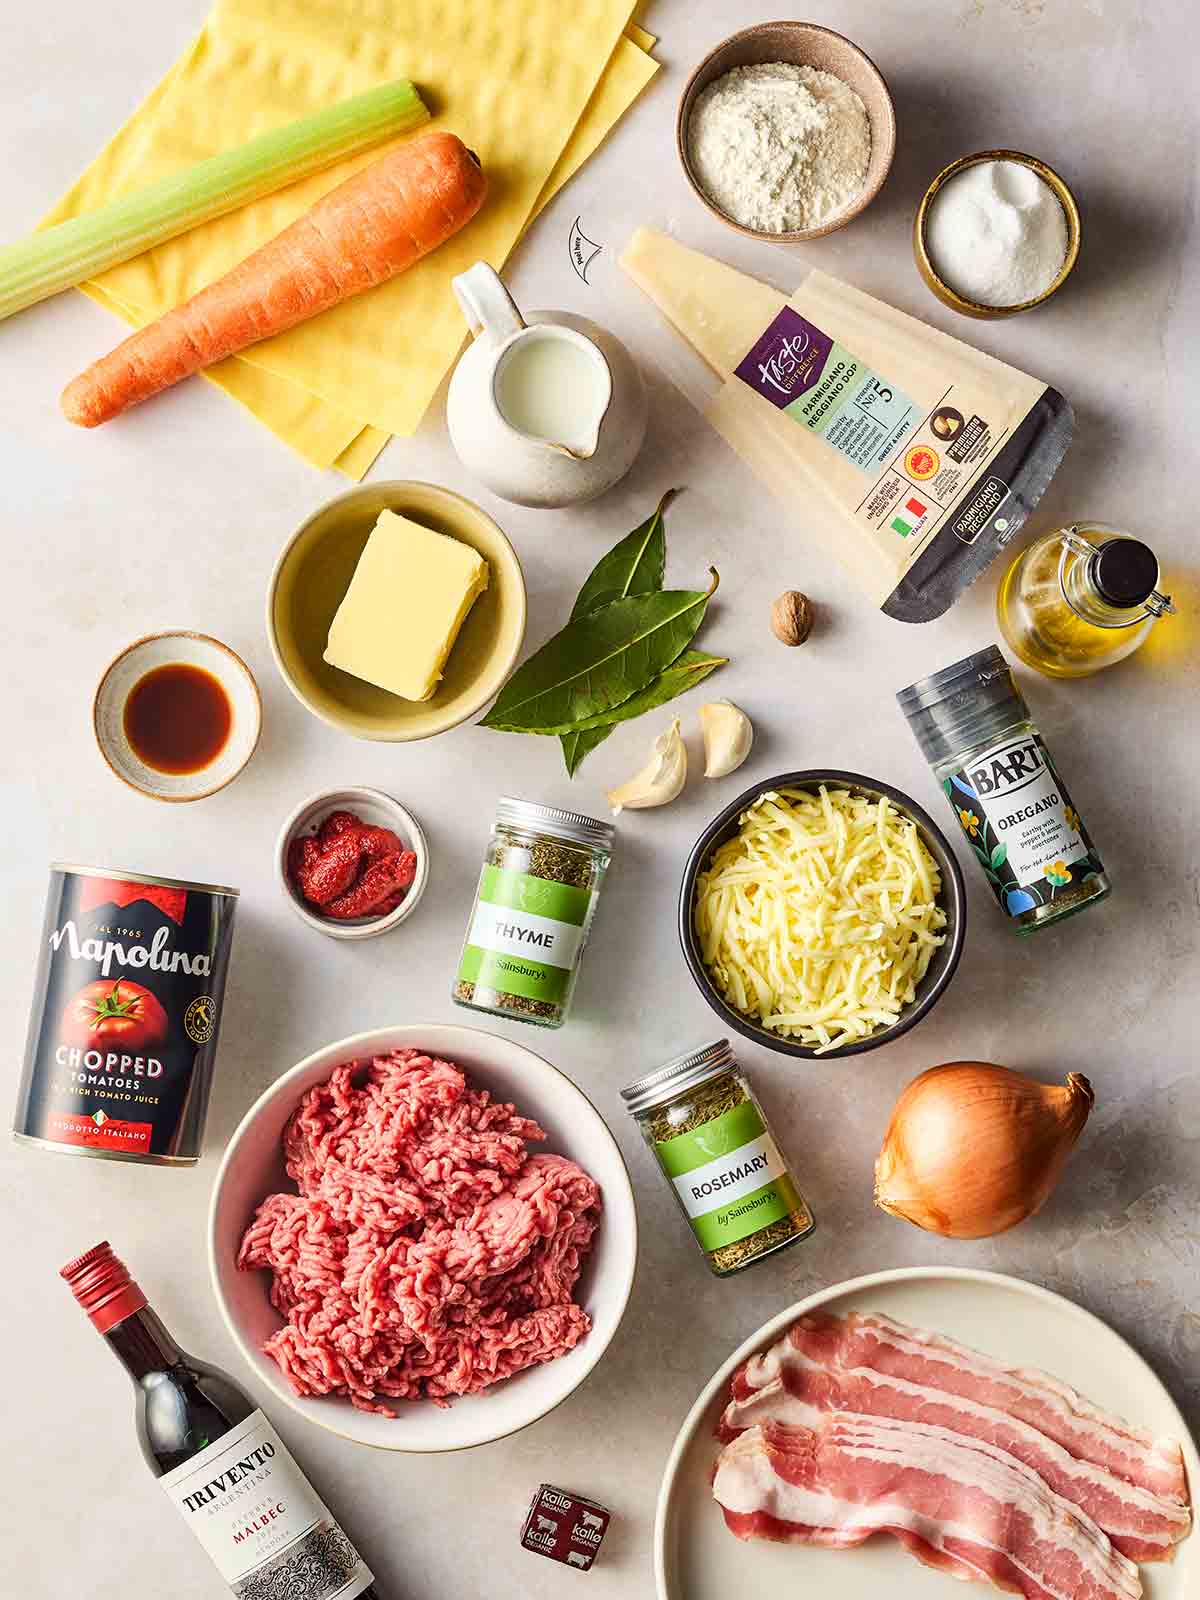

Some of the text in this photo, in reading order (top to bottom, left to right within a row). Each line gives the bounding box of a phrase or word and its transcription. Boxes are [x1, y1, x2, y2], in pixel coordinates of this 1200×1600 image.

[574, 251, 584, 265] Peel
[758, 330, 809, 394] taste
[784, 348, 819, 390] DIFFERENCE
[801, 361, 846, 415] PARMIGIANO
[806, 362, 859, 427] REGGIANO DOP
[854, 377, 876, 402] STRENGTH
[871, 381, 895, 403] 5
[877, 442, 894, 462] SWEET
[895, 421, 910, 439] NUTTY
[947, 417, 980, 456] PARMIGIANO
[957, 426, 983, 457] REGGIANO
[866, 480, 891, 510] MADE WITH
[866, 477, 900, 519] UNPASTEURISED
[888, 486, 900, 500] MILK
[956, 480, 999, 532] PARMIGIANO
[910, 515, 928, 536] ITALIAN
[967, 491, 1002, 533] REGGIANO
[970, 744, 1044, 796] BART
[998, 793, 1059, 831] OREGANO
[1019, 833, 1040, 848] pepper
[1045, 821, 1062, 835] lemon
[1021, 817, 1055, 838] Earthy with
[1030, 832, 1059, 851] overtones
[1019, 862, 1031, 872] For
[1031, 857, 1042, 866] the
[49, 920, 211, 976] Napolina
[117, 928, 142, 939] 1965
[496, 922, 554, 948] THYME
[56, 1046, 163, 1079] CHOPPED
[72, 1072, 140, 1090] TOMATOES
[94, 1089, 131, 1101] TOMATO
[134, 1095, 160, 1105] JUICE
[103, 1128, 146, 1140] ITALIANO
[691, 1152, 769, 1200] ROSEMARY
[717, 1213, 729, 1226] by
[182, 1441, 276, 1513] TRIVENTO
[207, 1469, 272, 1516] ARGENTINA
[540, 1501, 568, 1515] ORGANIC
[232, 1502, 287, 1545] MALBEC
[525, 1539, 552, 1554] ORGANIC
[570, 1535, 598, 1550] ORGANIC
